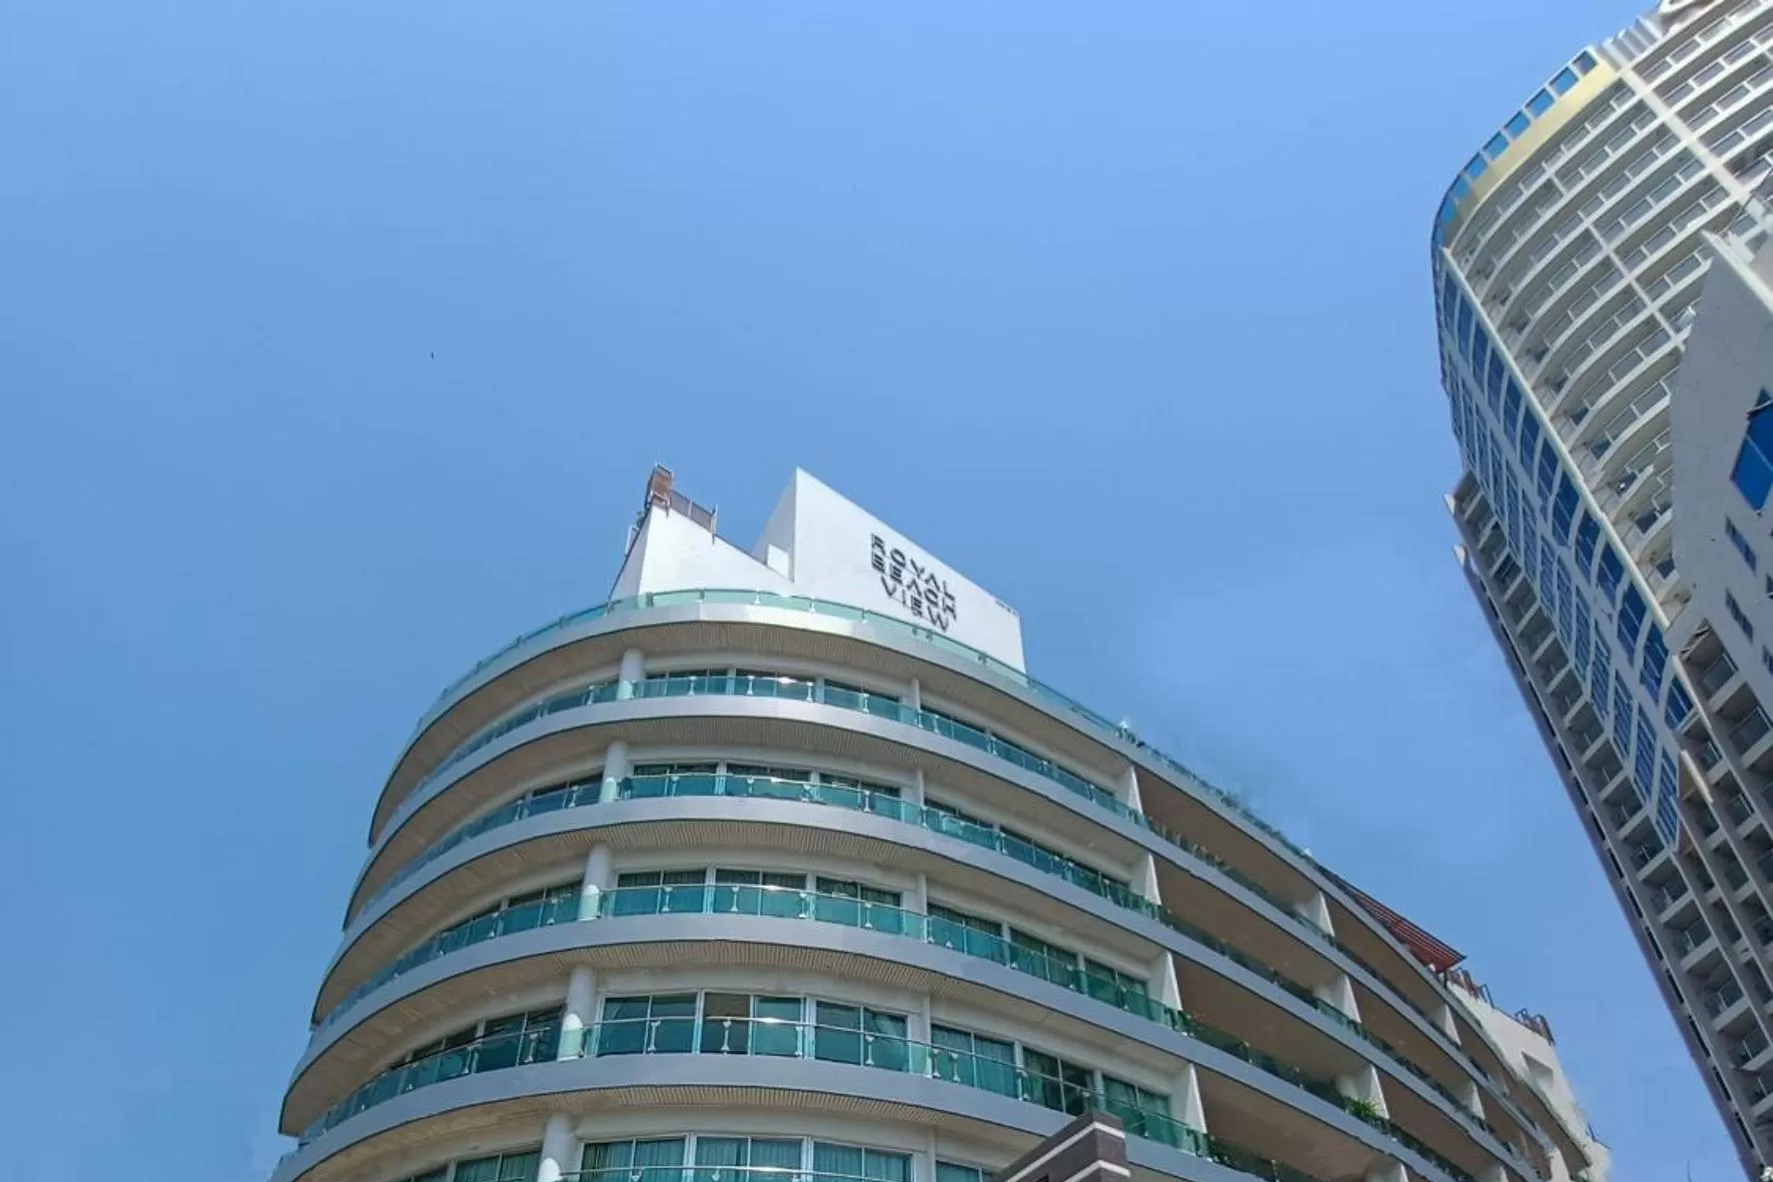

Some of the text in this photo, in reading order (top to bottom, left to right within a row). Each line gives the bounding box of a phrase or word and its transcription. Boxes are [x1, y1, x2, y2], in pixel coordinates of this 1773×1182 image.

[871, 532, 955, 602] ROYAL
[871, 552, 957, 621] BEACH
[881, 576, 948, 632] VIEW
